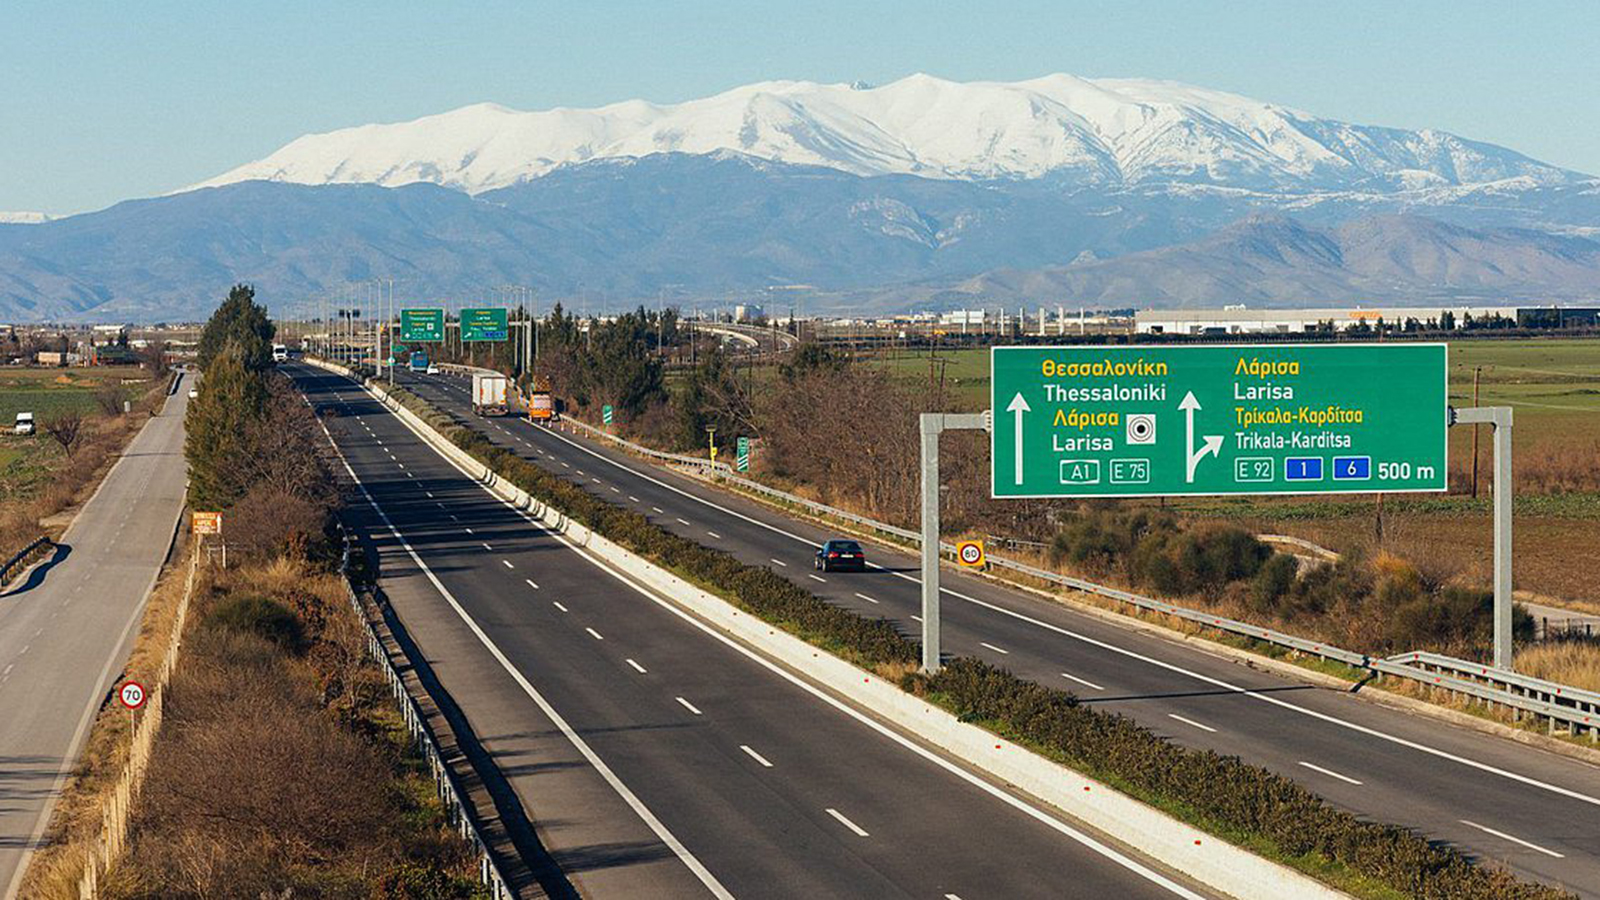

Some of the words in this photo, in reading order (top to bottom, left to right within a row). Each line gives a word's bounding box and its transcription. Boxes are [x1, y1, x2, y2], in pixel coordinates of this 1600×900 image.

[1042, 358, 1168, 377] Θεσσαλονίκη
[1234, 357, 1300, 379] Λάρισα
[1043, 384, 1167, 402] Thessaloniki
[1234, 382, 1294, 400] Larisa
[1053, 408, 1119, 431] Λάρισα
[1235, 405, 1363, 428] Τρίκαλα-Καρδίτσα
[1052, 433, 1114, 452] Larisa
[1235, 430, 1352, 449] Trikala-Karditsa
[1071, 464, 1090, 479] A1
[1114, 463, 1124, 479] E
[1129, 463, 1145, 479] 75
[1239, 461, 1248, 477] E
[1253, 461, 1270, 477] 92
[1347, 460, 1357, 476] 6
[1378, 462, 1411, 480] 500
[1416, 466, 1435, 480] m
[125, 689, 141, 701] 70
